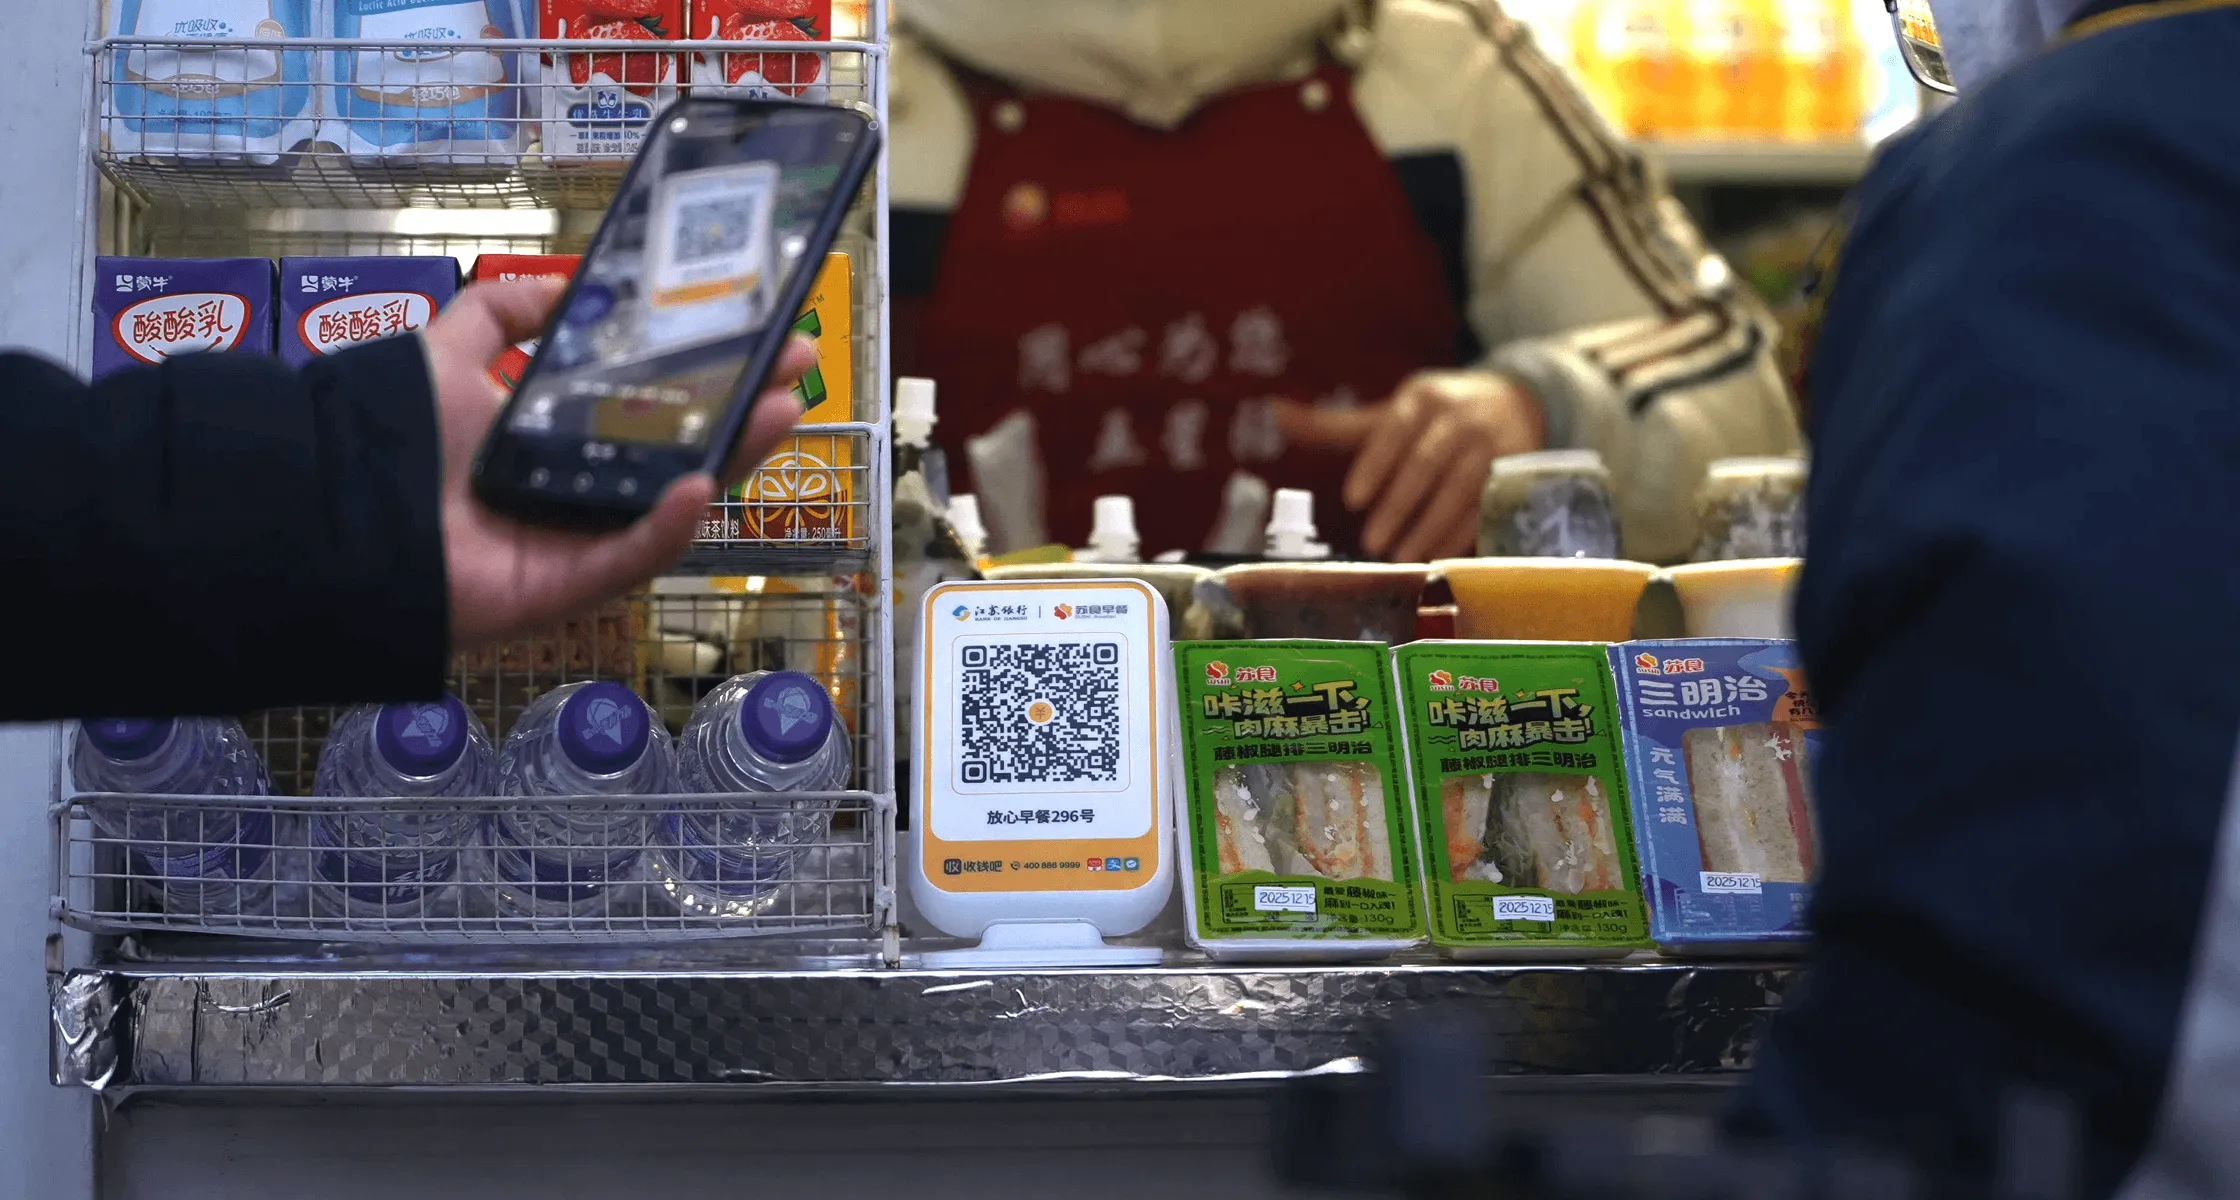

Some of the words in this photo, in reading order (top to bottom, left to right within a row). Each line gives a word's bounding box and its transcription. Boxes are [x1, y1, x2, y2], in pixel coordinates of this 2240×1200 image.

[136, 276, 168, 292] 蒙牛
[321, 276, 353, 292] 蒙牛
[133, 300, 233, 344] 酸酸乳
[318, 299, 419, 344] 酸酸乳
[974, 604, 1028, 617] 江苏银行
[1075, 604, 1128, 615] 苏食早餐
[1236, 666, 1277, 682] 苏食
[1663, 658, 1704, 674] 苏食
[1459, 676, 1499, 693] 苏食
[1638, 675, 1768, 706] 三明治
[1642, 705, 1741, 719] sandwich
[1214, 740, 1373, 761] 藤椒腿排三明治
[1440, 752, 1598, 773] 藤椒腿排三明治
[1649, 746, 1688, 825] 元气满满
[987, 808, 1096, 825] 放心早餐296号
[963, 860, 1003, 873] 收钱吧
[1059, 861, 1081, 869] 9999
